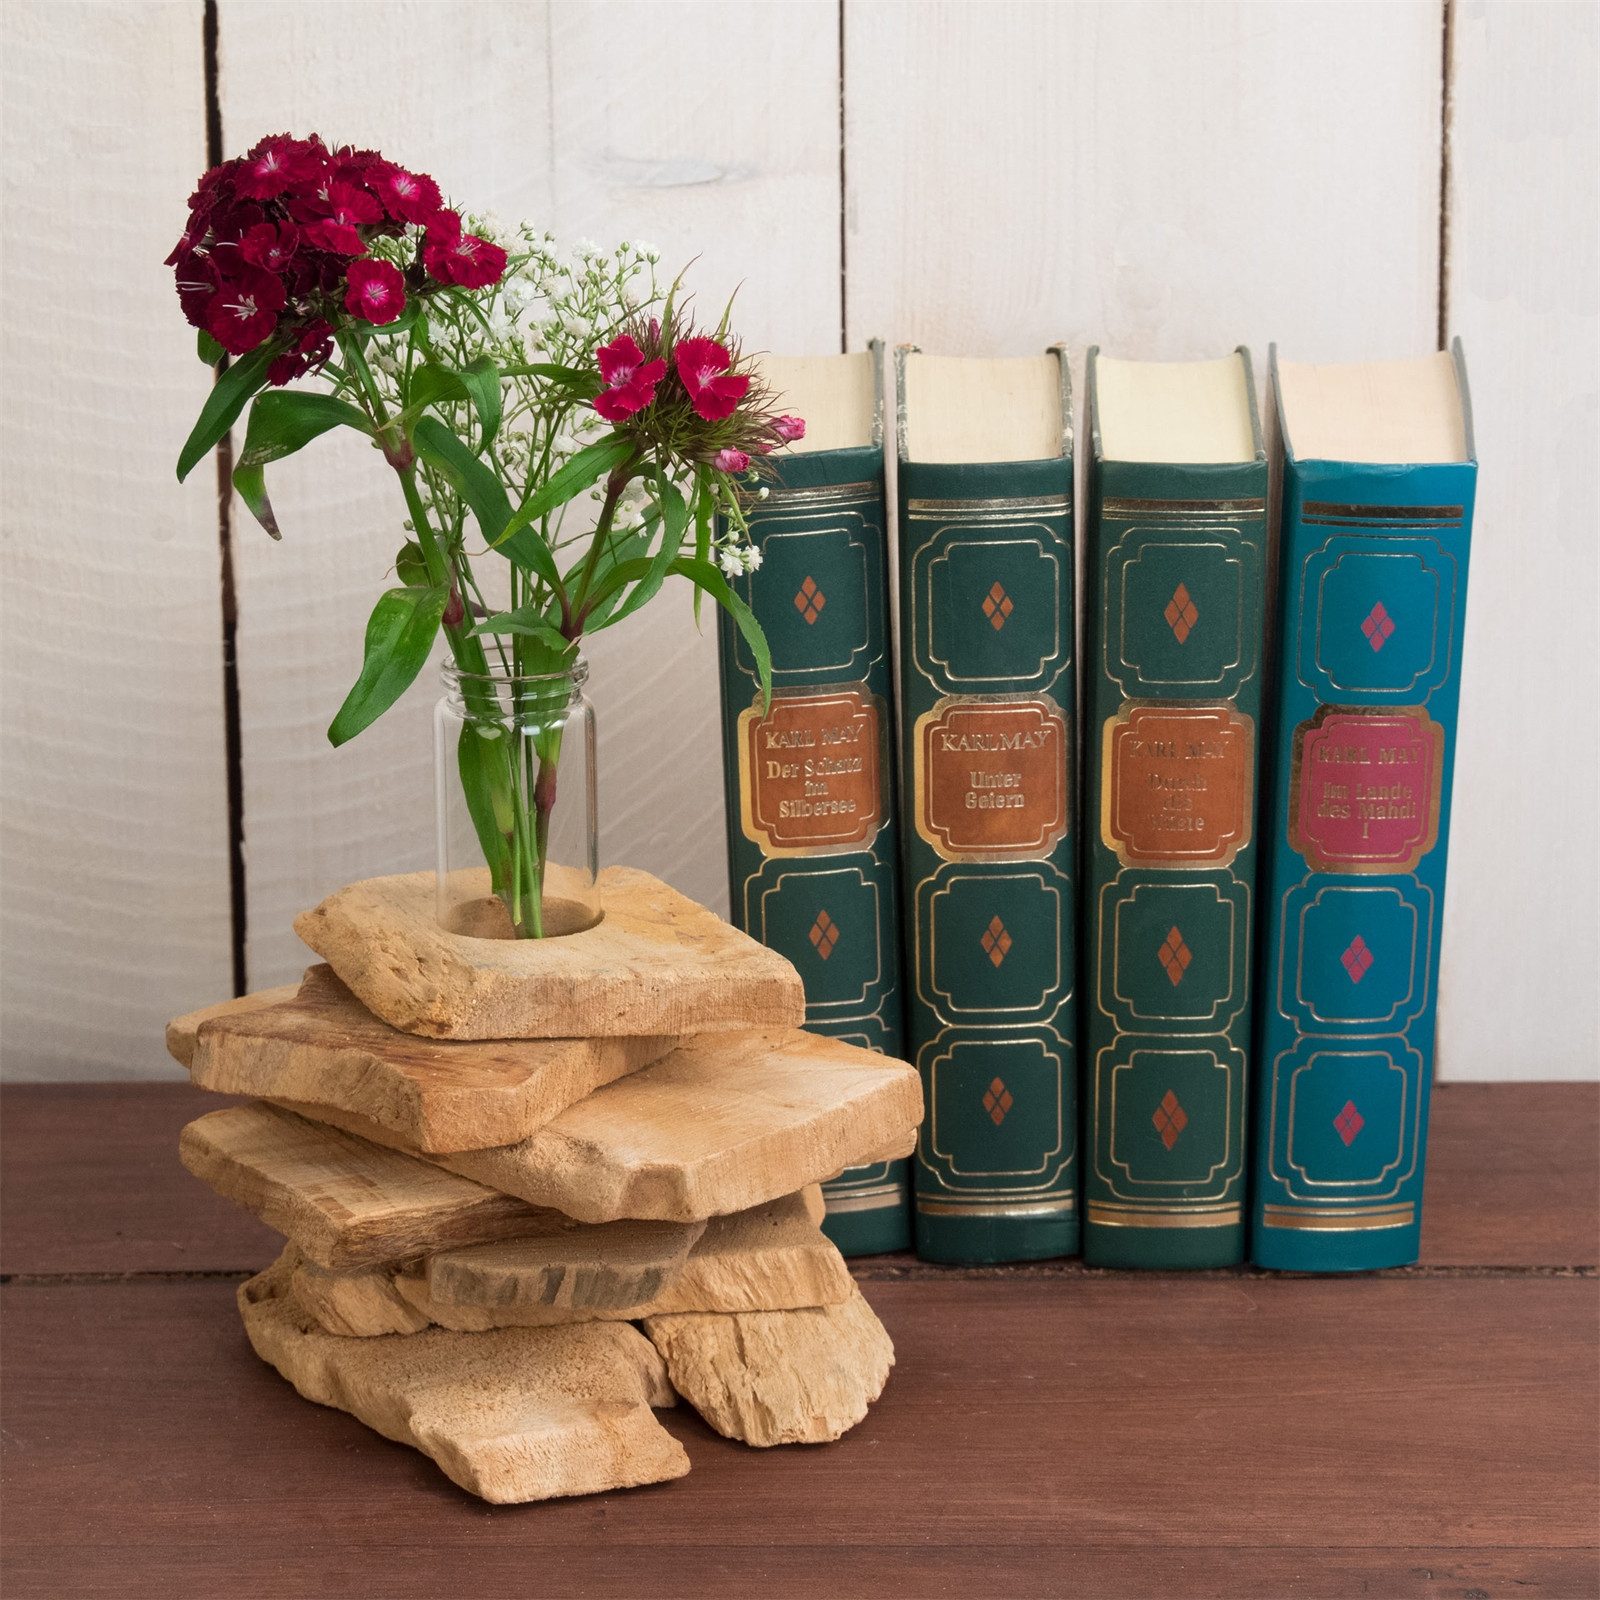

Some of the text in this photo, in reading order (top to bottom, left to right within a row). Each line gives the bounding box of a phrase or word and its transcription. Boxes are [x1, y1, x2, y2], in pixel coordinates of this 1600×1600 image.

[766, 724, 863, 749] KARL MAY
[1318, 747, 1371, 764] KARL
[766, 761, 799, 778] Der
[970, 771, 1022, 788] Unter
[1356, 782, 1413, 800] Lande
[779, 800, 856, 817] Silbersee
[965, 792, 1025, 809] Geiern
[1317, 802, 1416, 820] des Mahdi
[1362, 822, 1369, 839] I
